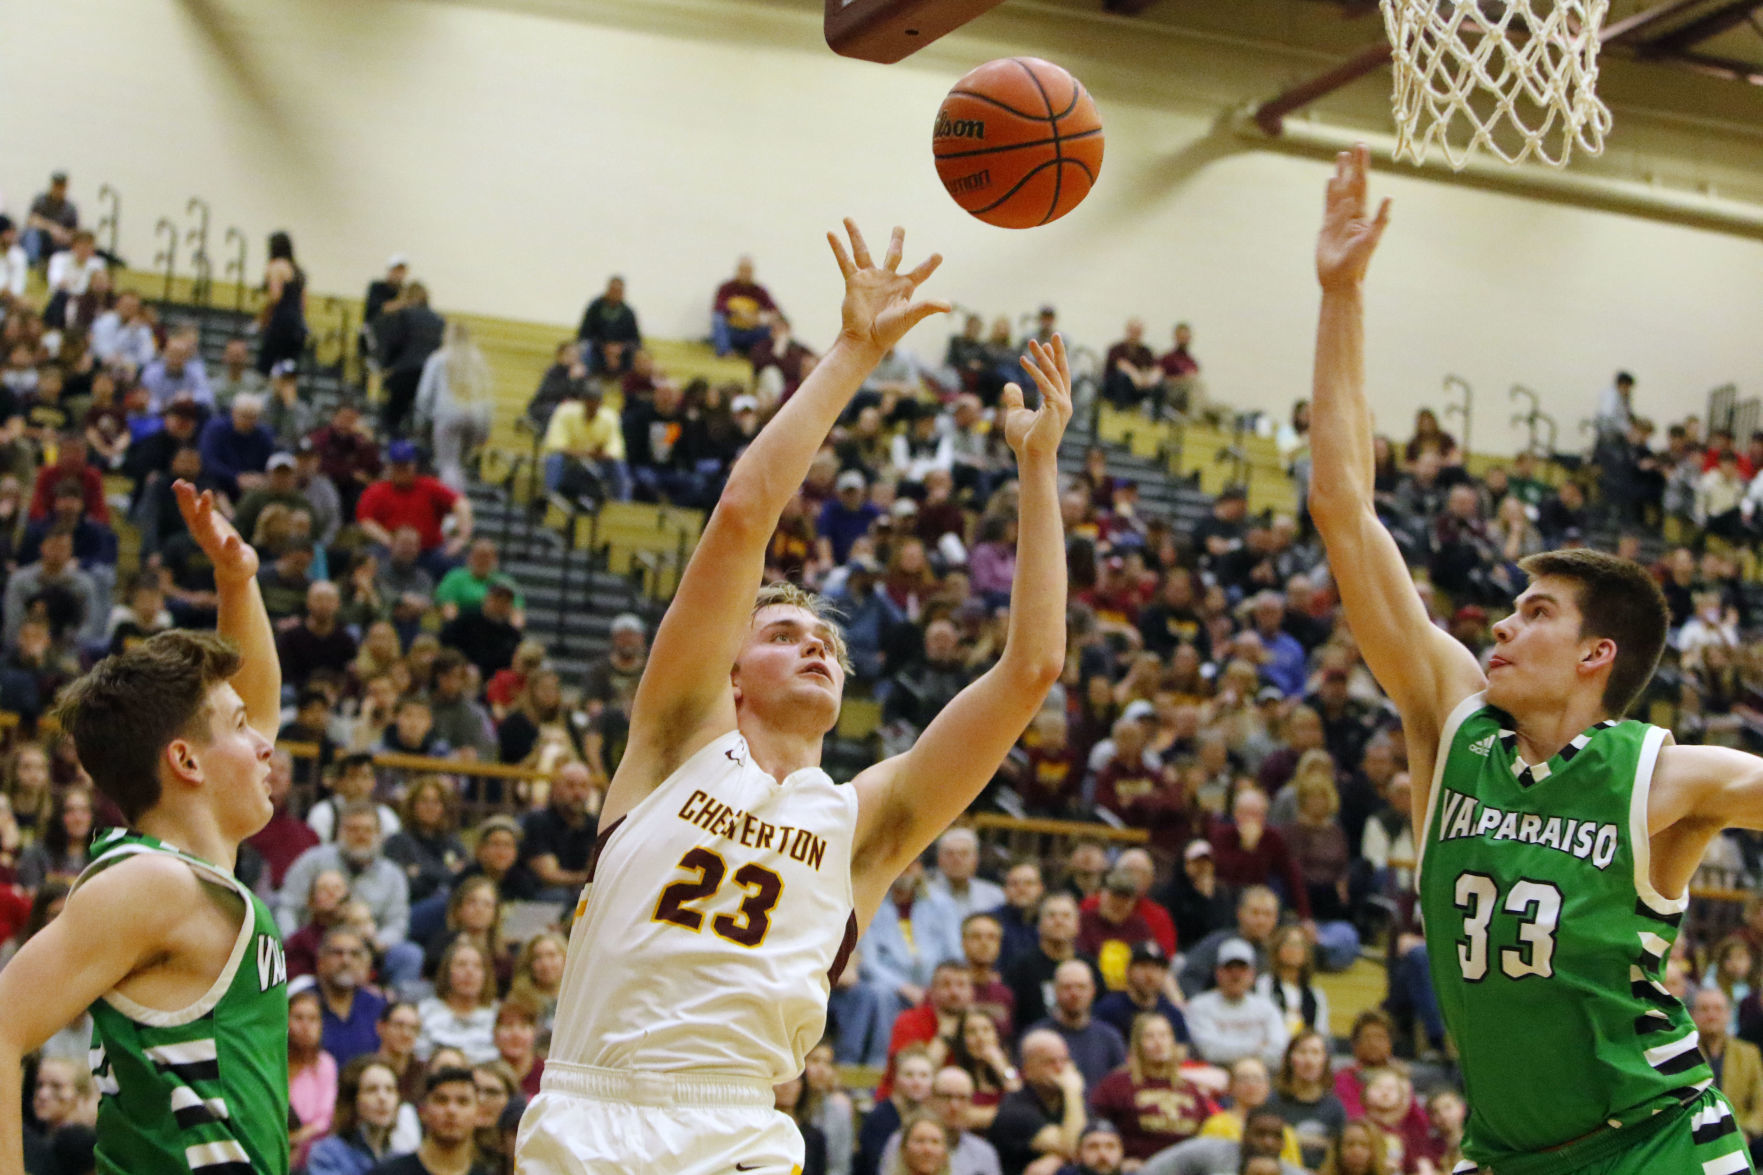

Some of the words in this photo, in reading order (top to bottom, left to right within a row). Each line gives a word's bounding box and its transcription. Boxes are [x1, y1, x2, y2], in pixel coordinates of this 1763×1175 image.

[935, 110, 984, 139] lson
[651, 845, 785, 949] 23
[1453, 869, 1565, 983] 33
